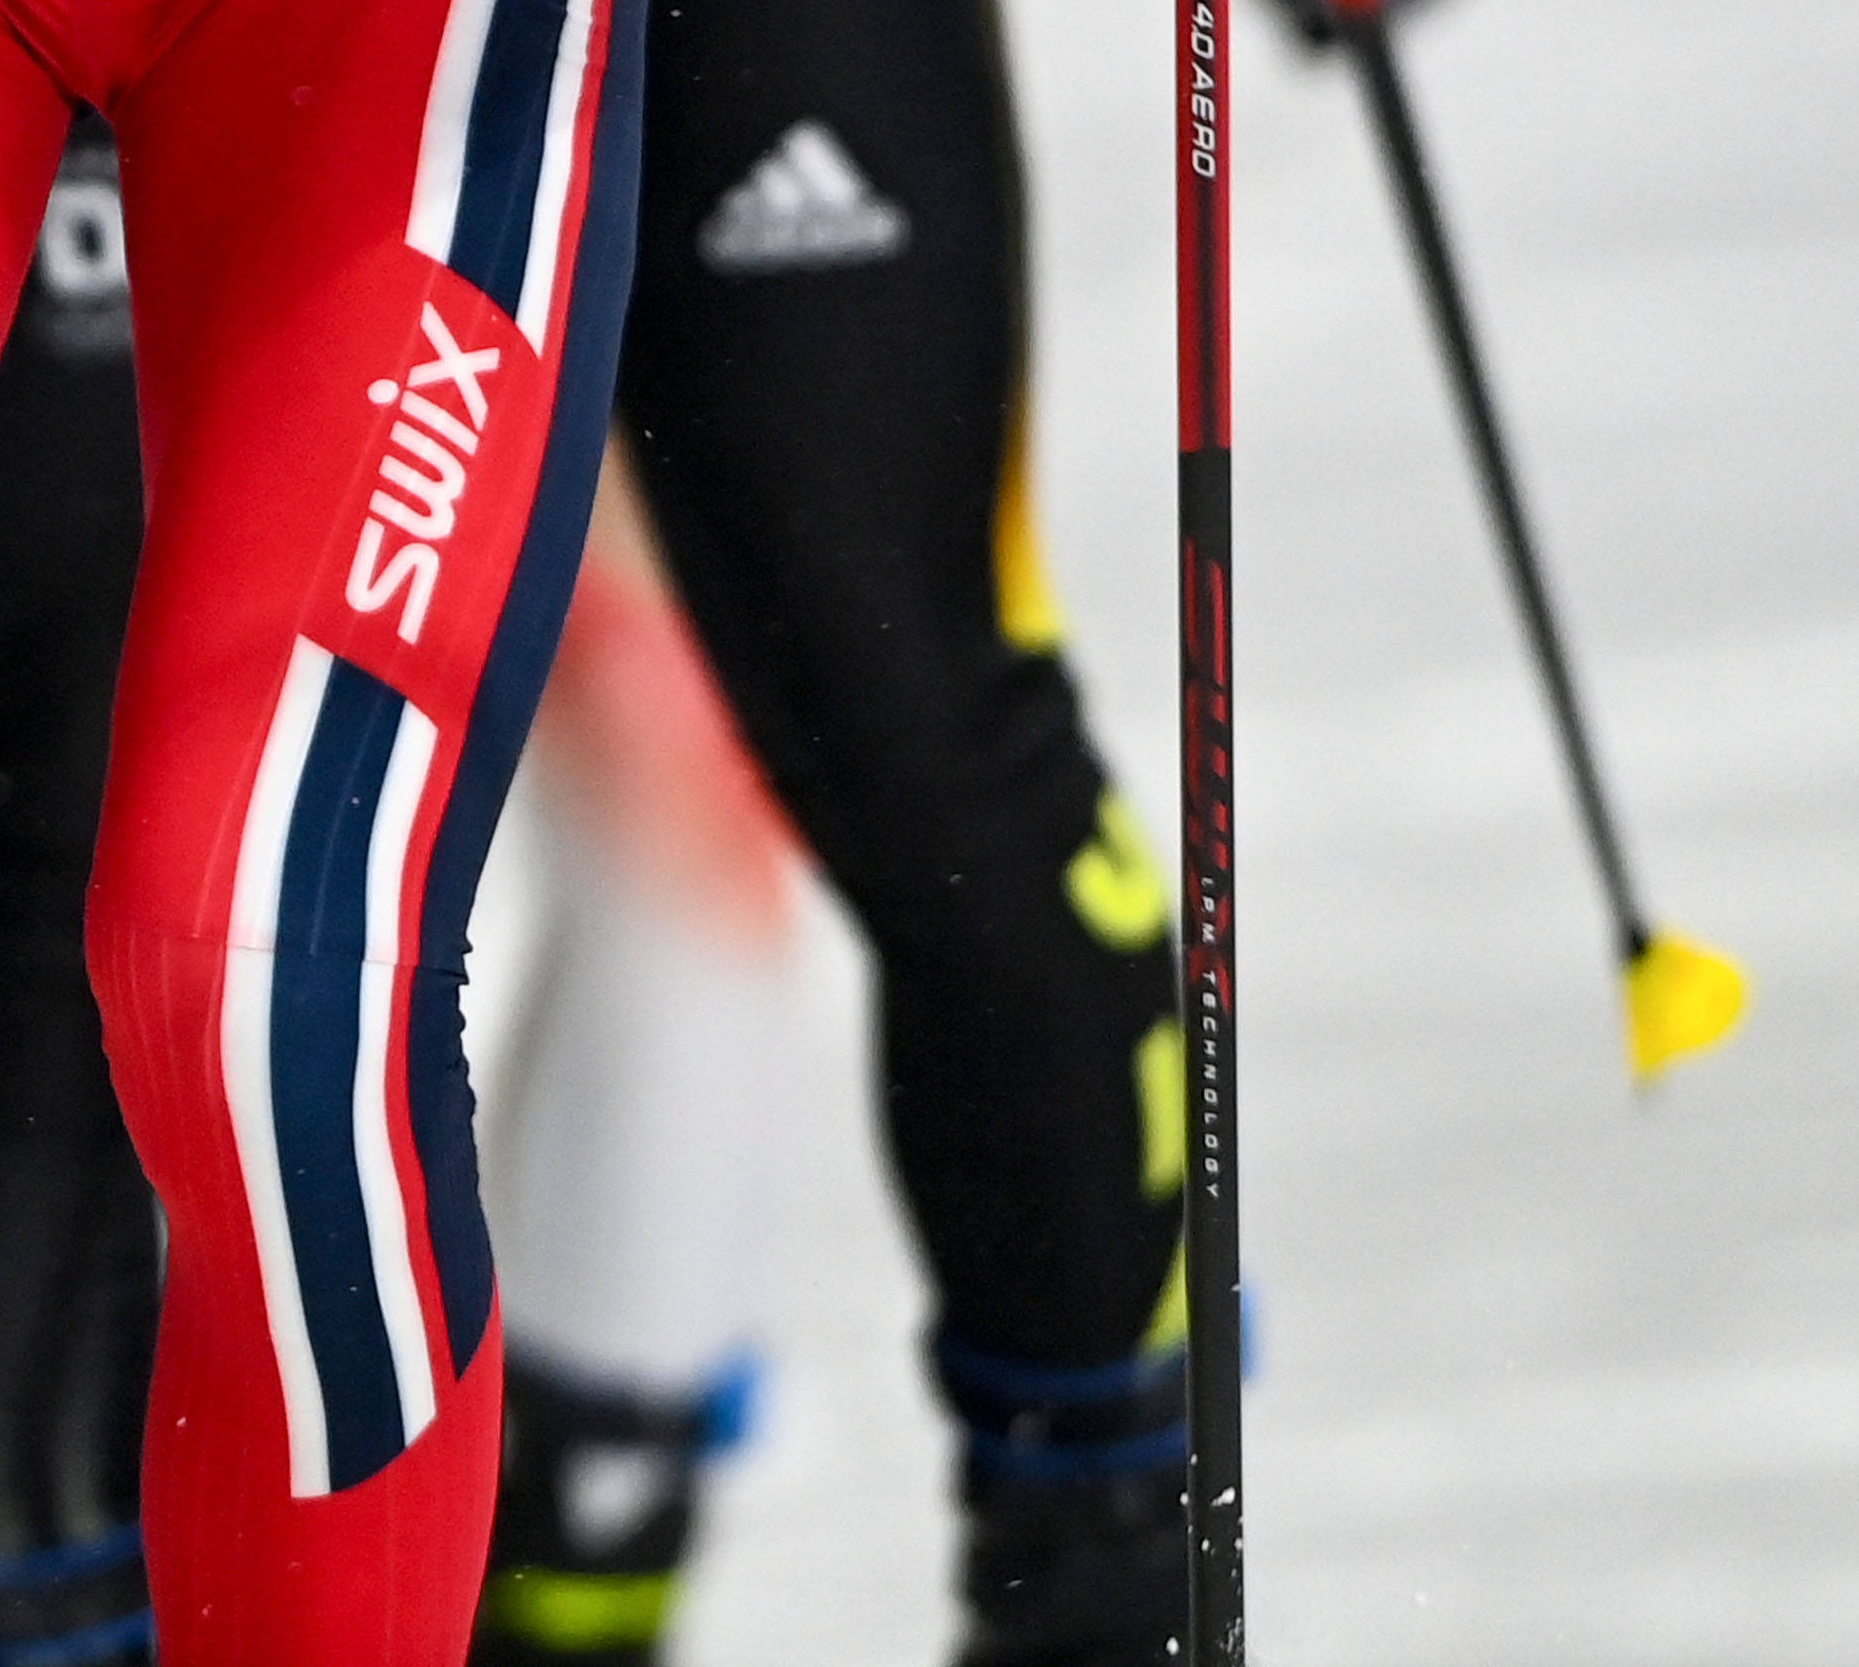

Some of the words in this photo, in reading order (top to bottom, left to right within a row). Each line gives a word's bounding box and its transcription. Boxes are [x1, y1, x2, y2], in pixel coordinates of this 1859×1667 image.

[1190, 63, 1216, 178] AERO
[345, 302, 500, 644] swix
[1203, 971, 1220, 1200] TECHNOLOGY
